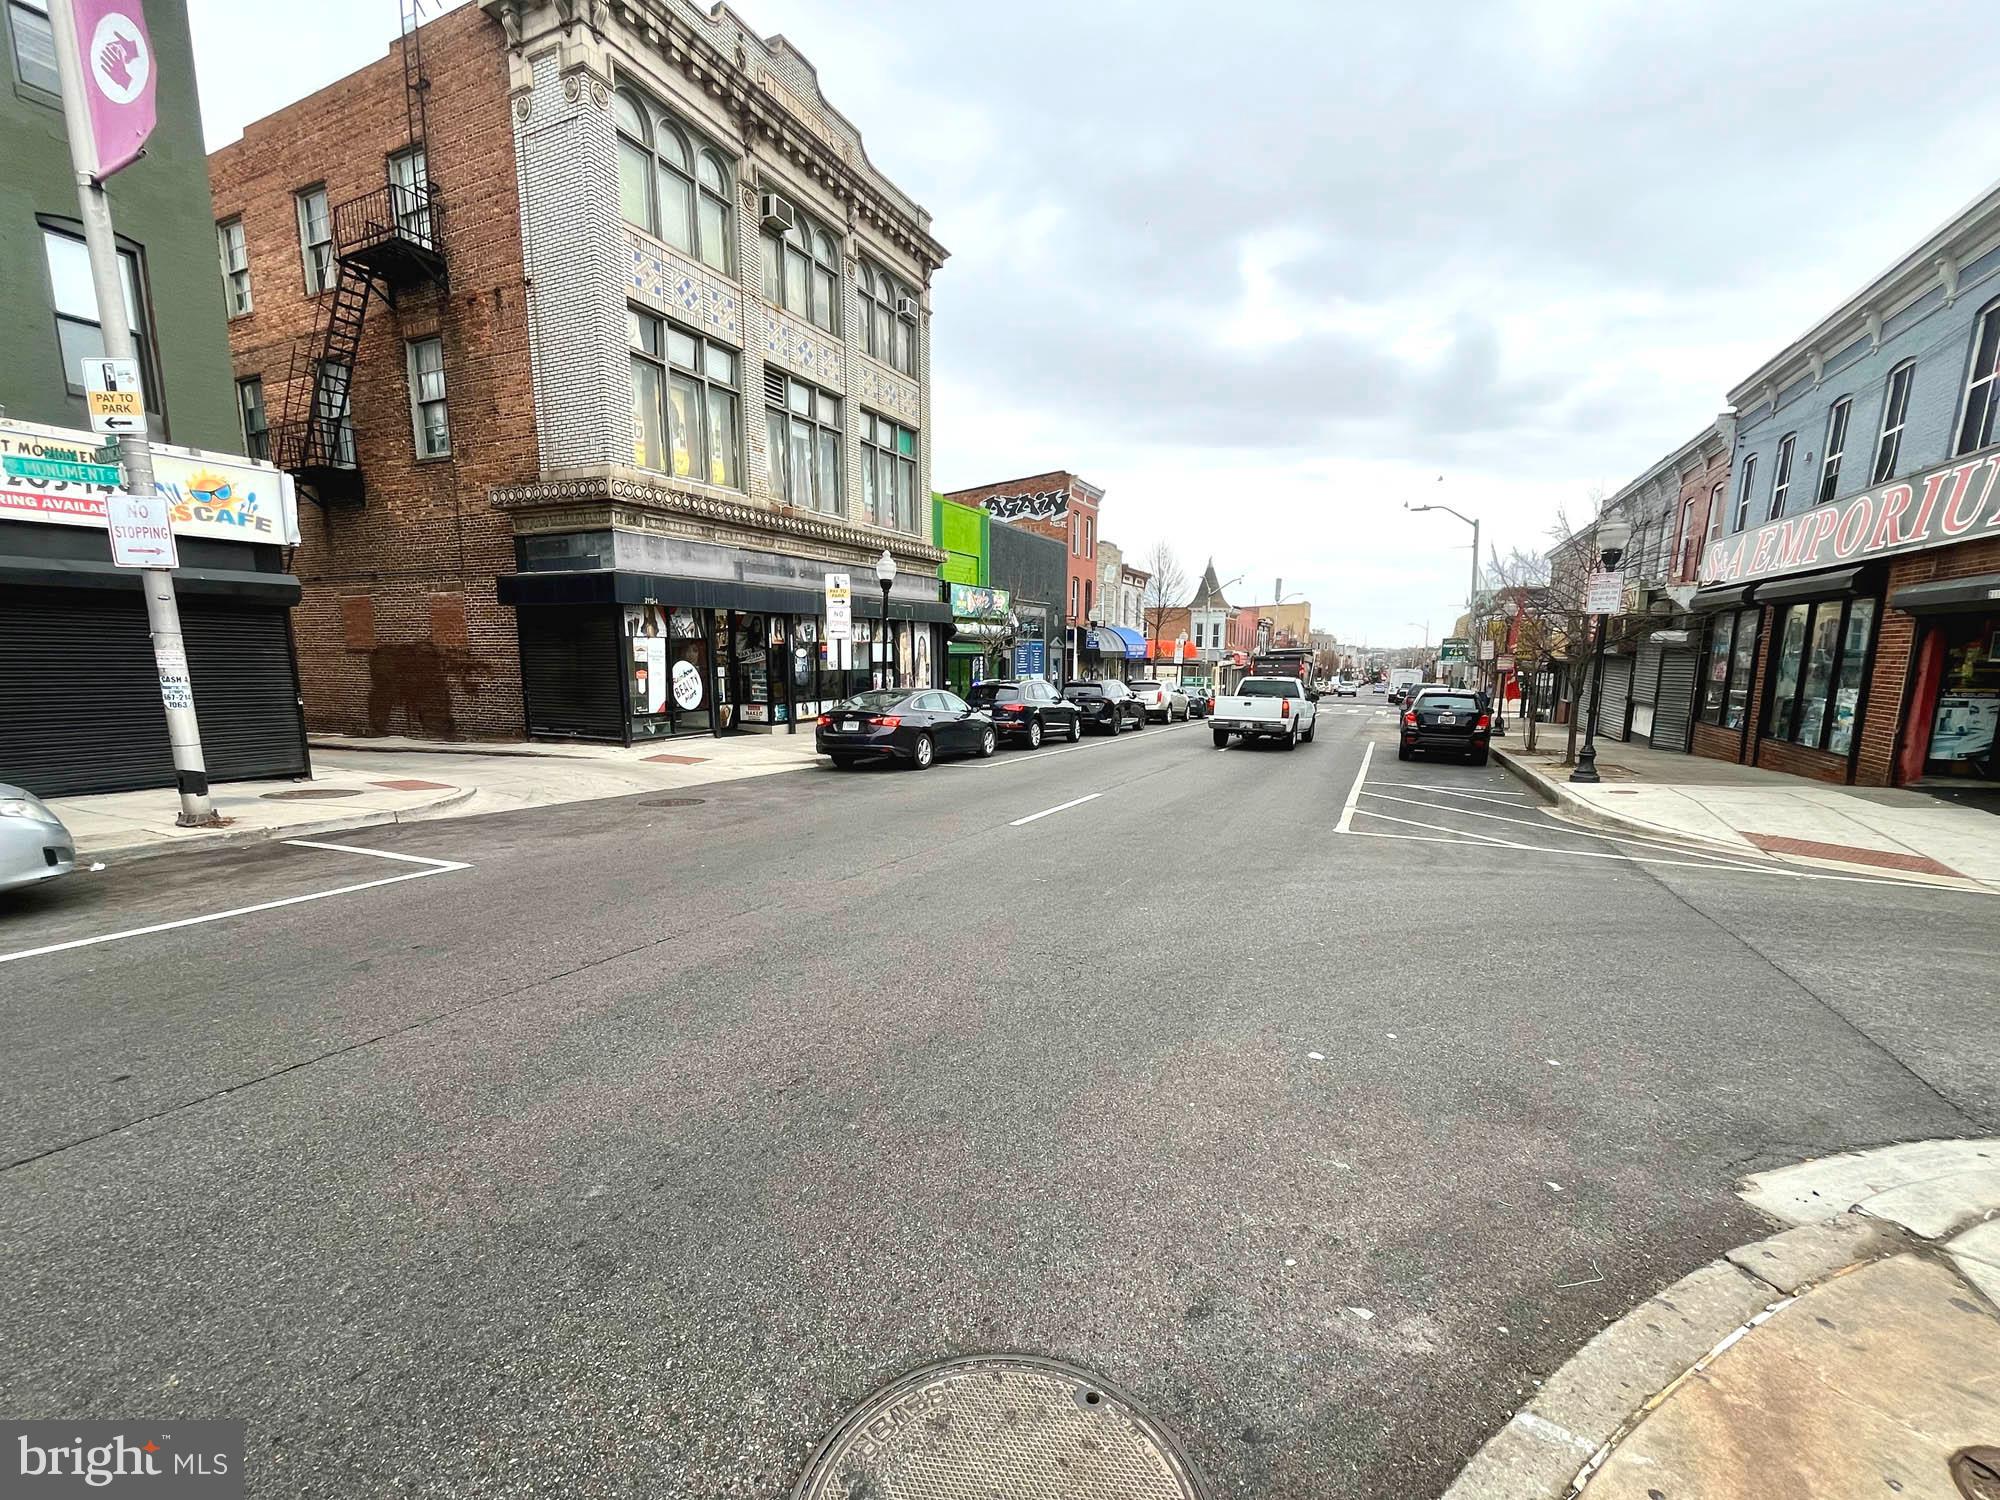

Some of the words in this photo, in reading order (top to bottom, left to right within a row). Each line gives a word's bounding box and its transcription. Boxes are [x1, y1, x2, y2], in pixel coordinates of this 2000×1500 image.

[96, 393, 115, 403] PAY
[119, 393, 133, 403] TO
[102, 404, 132, 414] PARK
[24, 461, 105, 480] MONUMENT
[127, 504, 149, 518] NO
[1746, 453, 2000, 576] EMPORIU
[115, 526, 168, 539] STOPPING
[674, 676, 699, 699] BEAUTY
